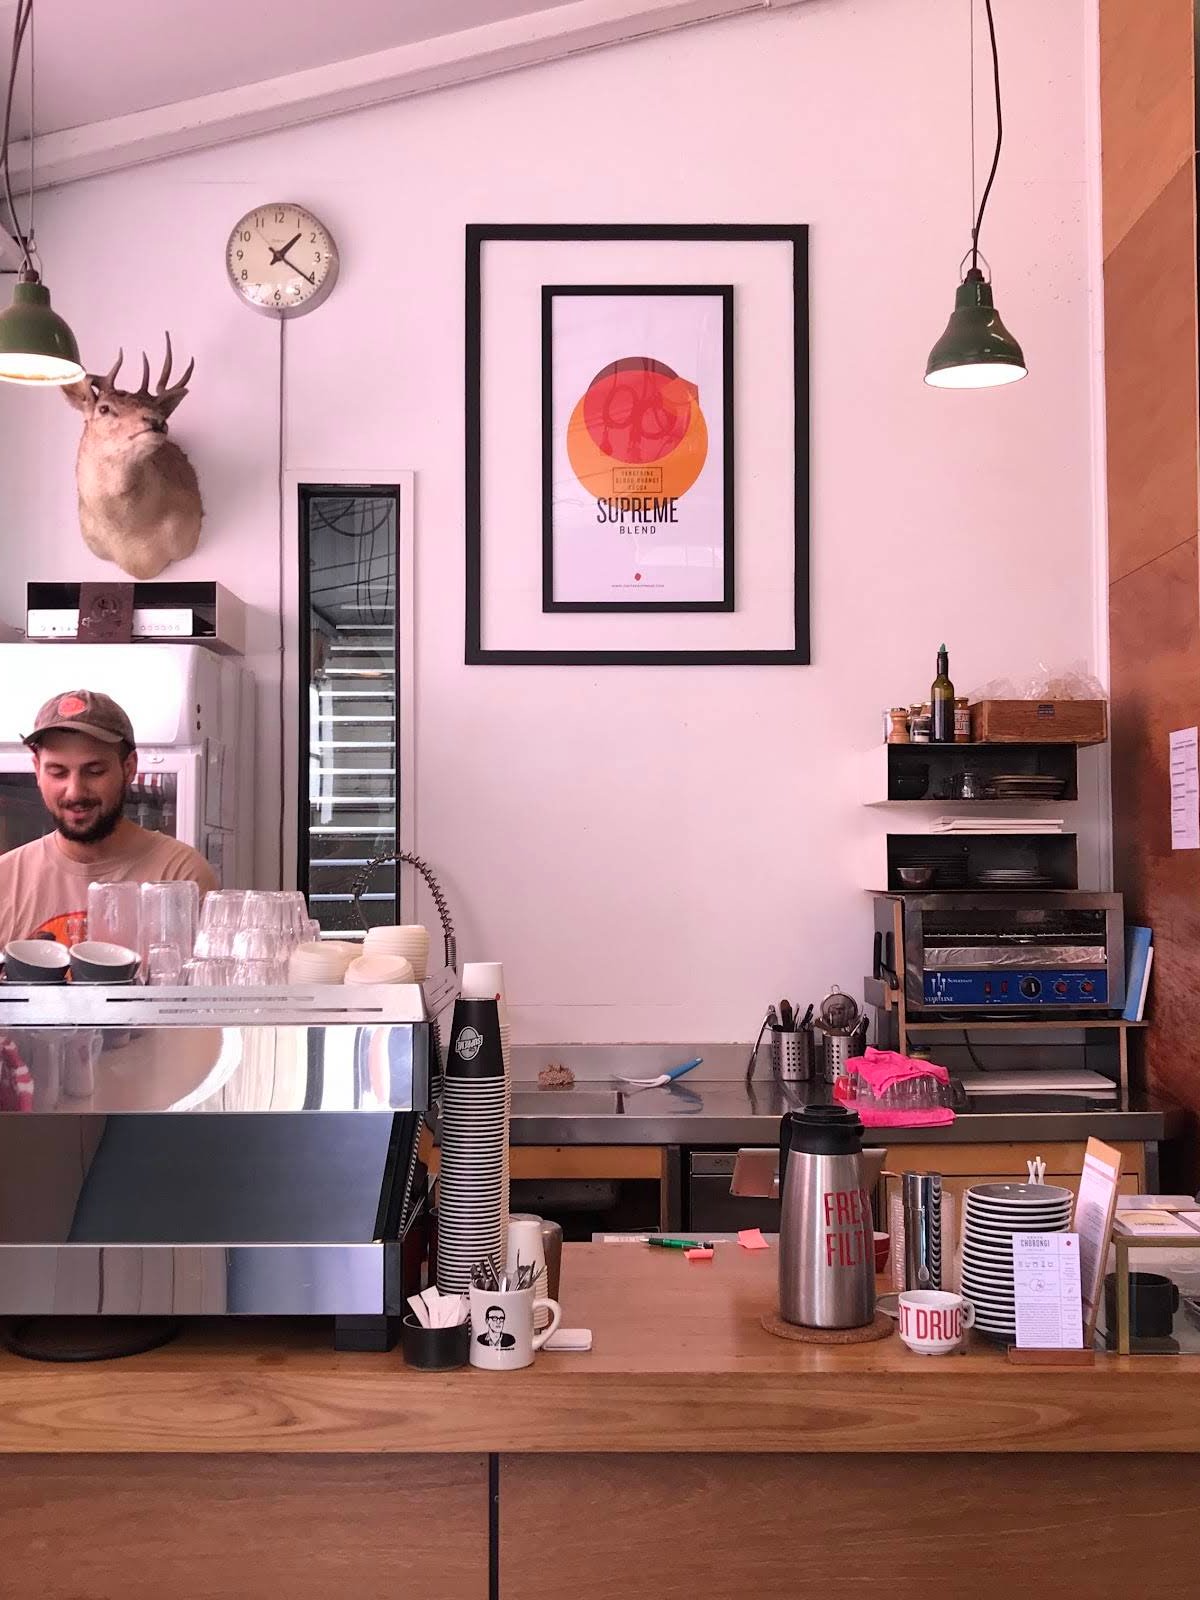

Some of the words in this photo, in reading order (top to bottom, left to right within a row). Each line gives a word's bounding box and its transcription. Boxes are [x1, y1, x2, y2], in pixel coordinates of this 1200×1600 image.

[255, 218, 264, 228] 11
[274, 212, 285, 223] 12
[240, 231, 251, 242] 10
[310, 233, 317, 243] 2
[236, 250, 244, 260] 9
[314, 252, 321, 263] 3
[241, 269, 248, 280] 8
[309, 271, 315, 282] 4
[274, 289, 281, 300] 6
[294, 285, 301, 296] 5
[596, 496, 679, 523] SUPREME
[619, 525, 656, 535] BLEND
